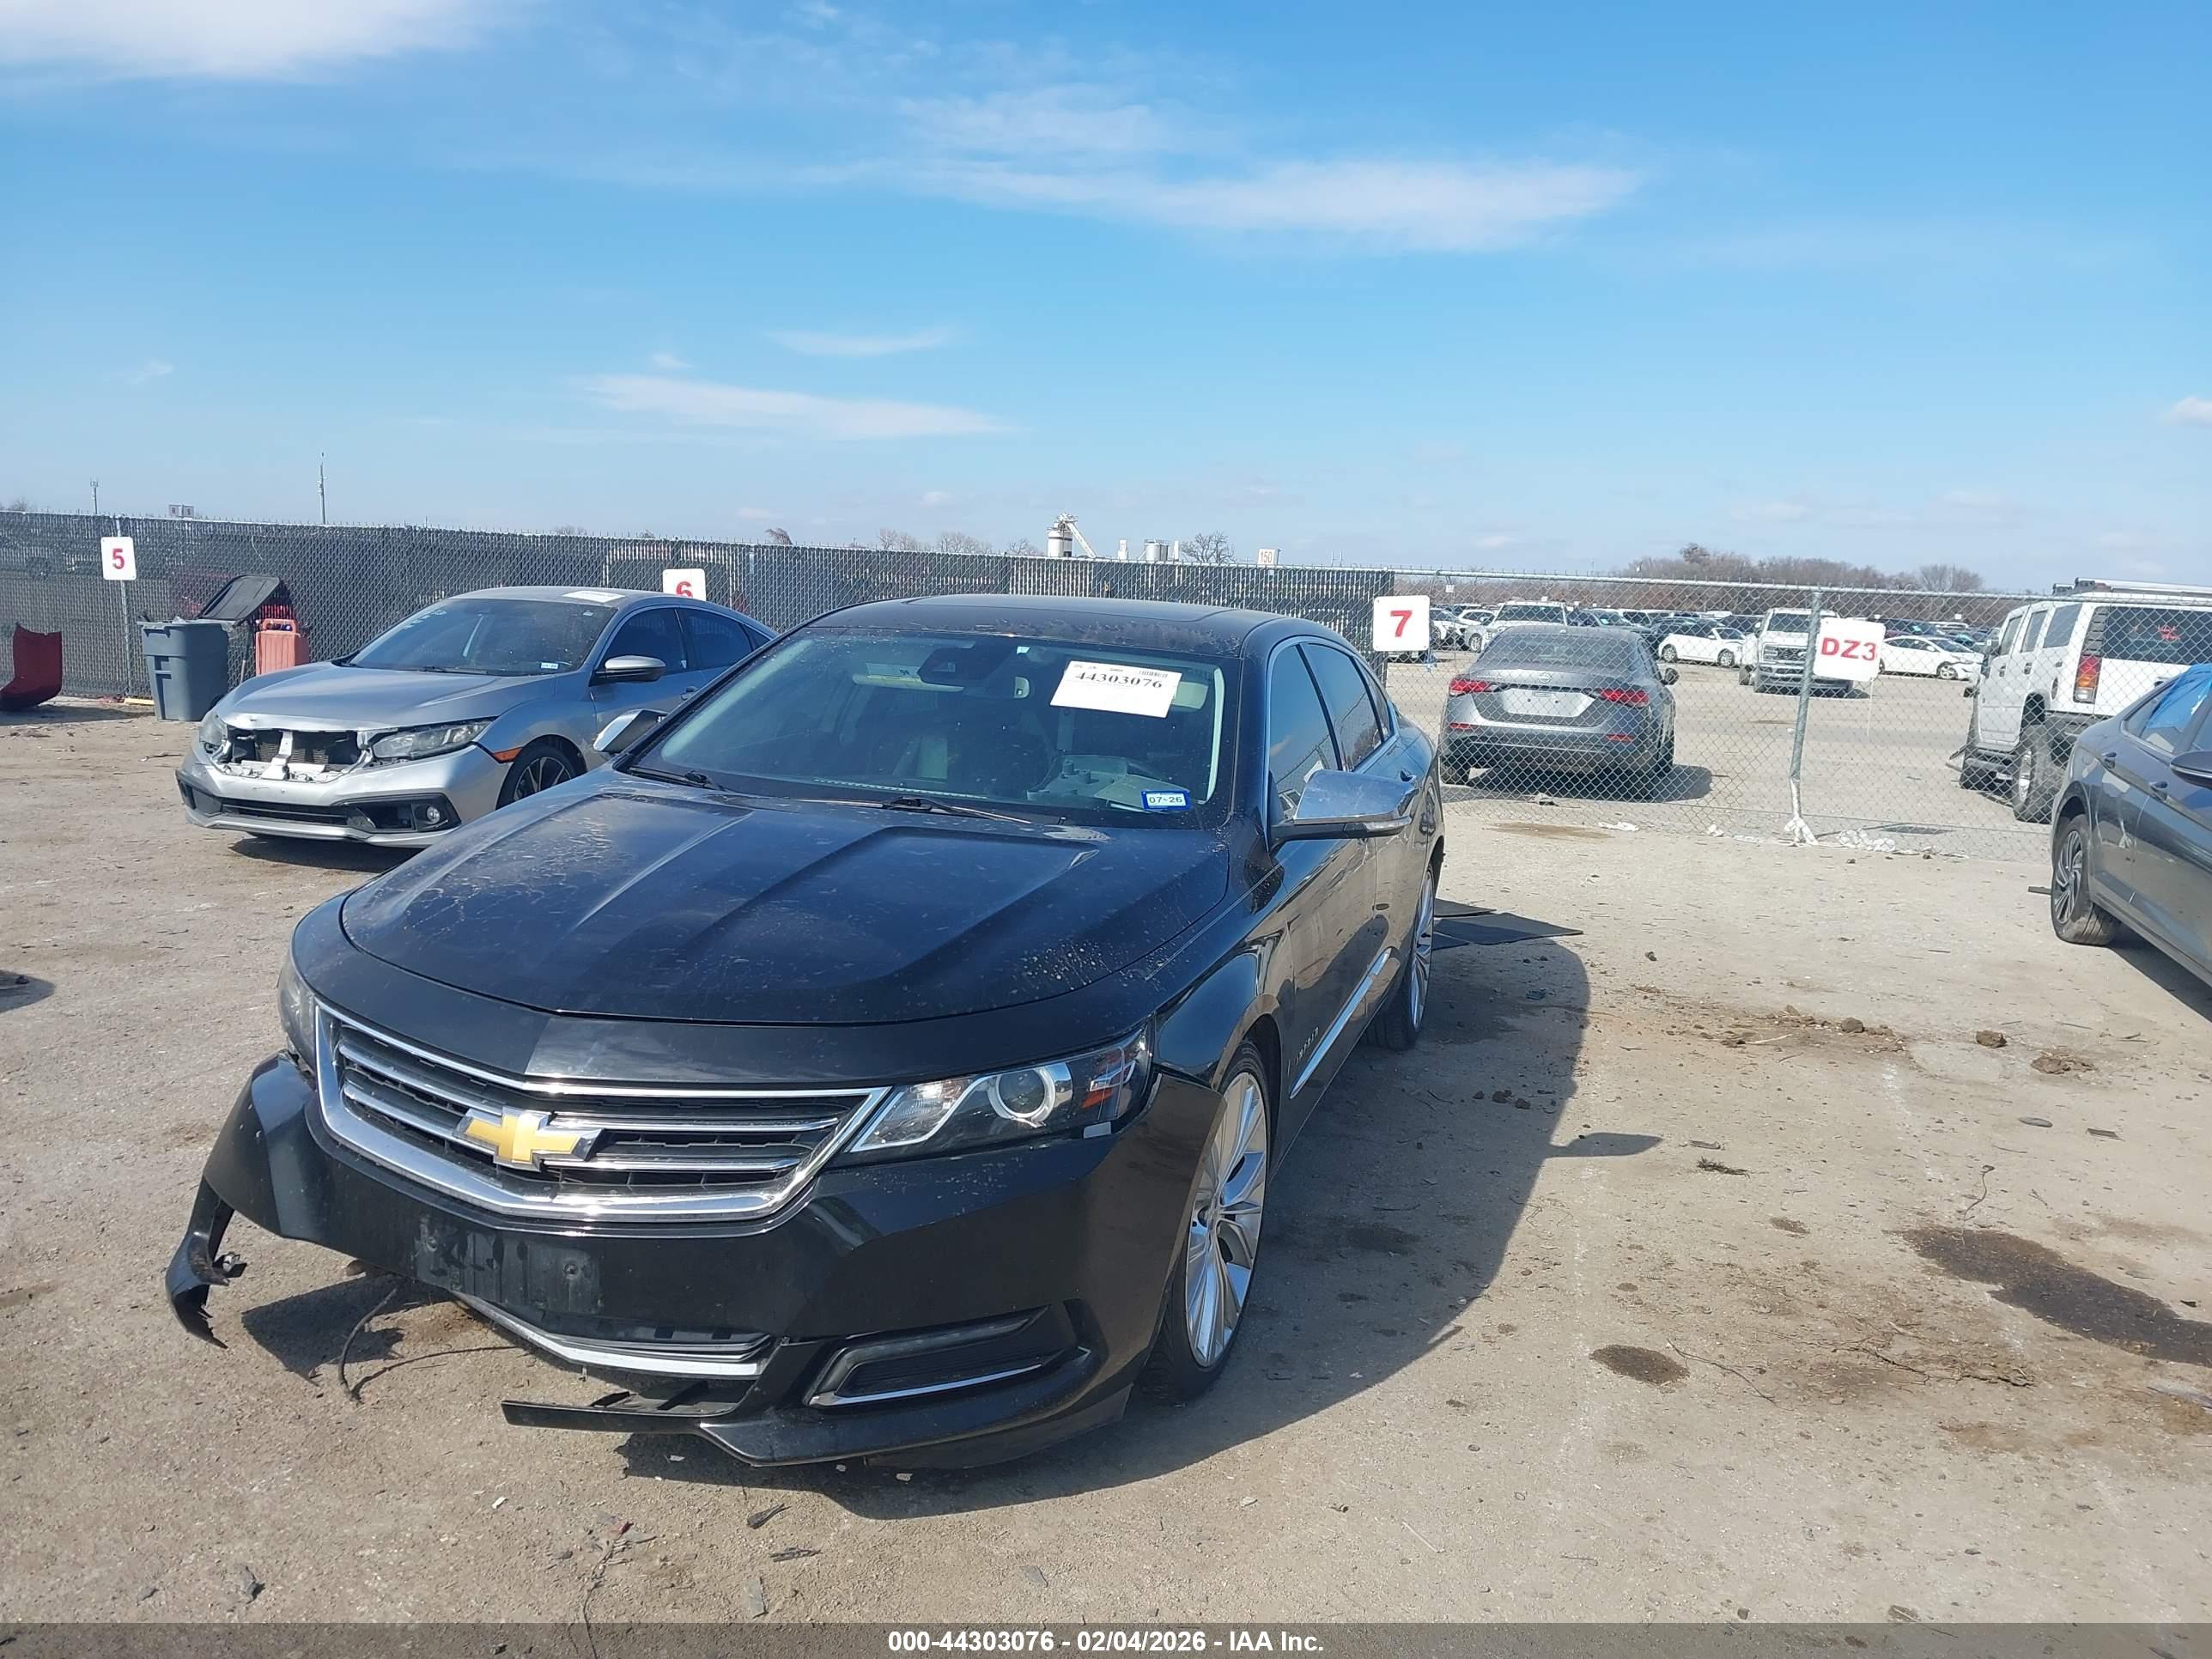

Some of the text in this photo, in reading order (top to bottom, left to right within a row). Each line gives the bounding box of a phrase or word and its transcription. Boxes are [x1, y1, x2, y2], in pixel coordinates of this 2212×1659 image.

[112, 548, 125, 569] 5
[1390, 609, 1413, 638] 7
[1820, 637, 1877, 661] DZ3
[1075, 672, 1163, 689] 44303076
